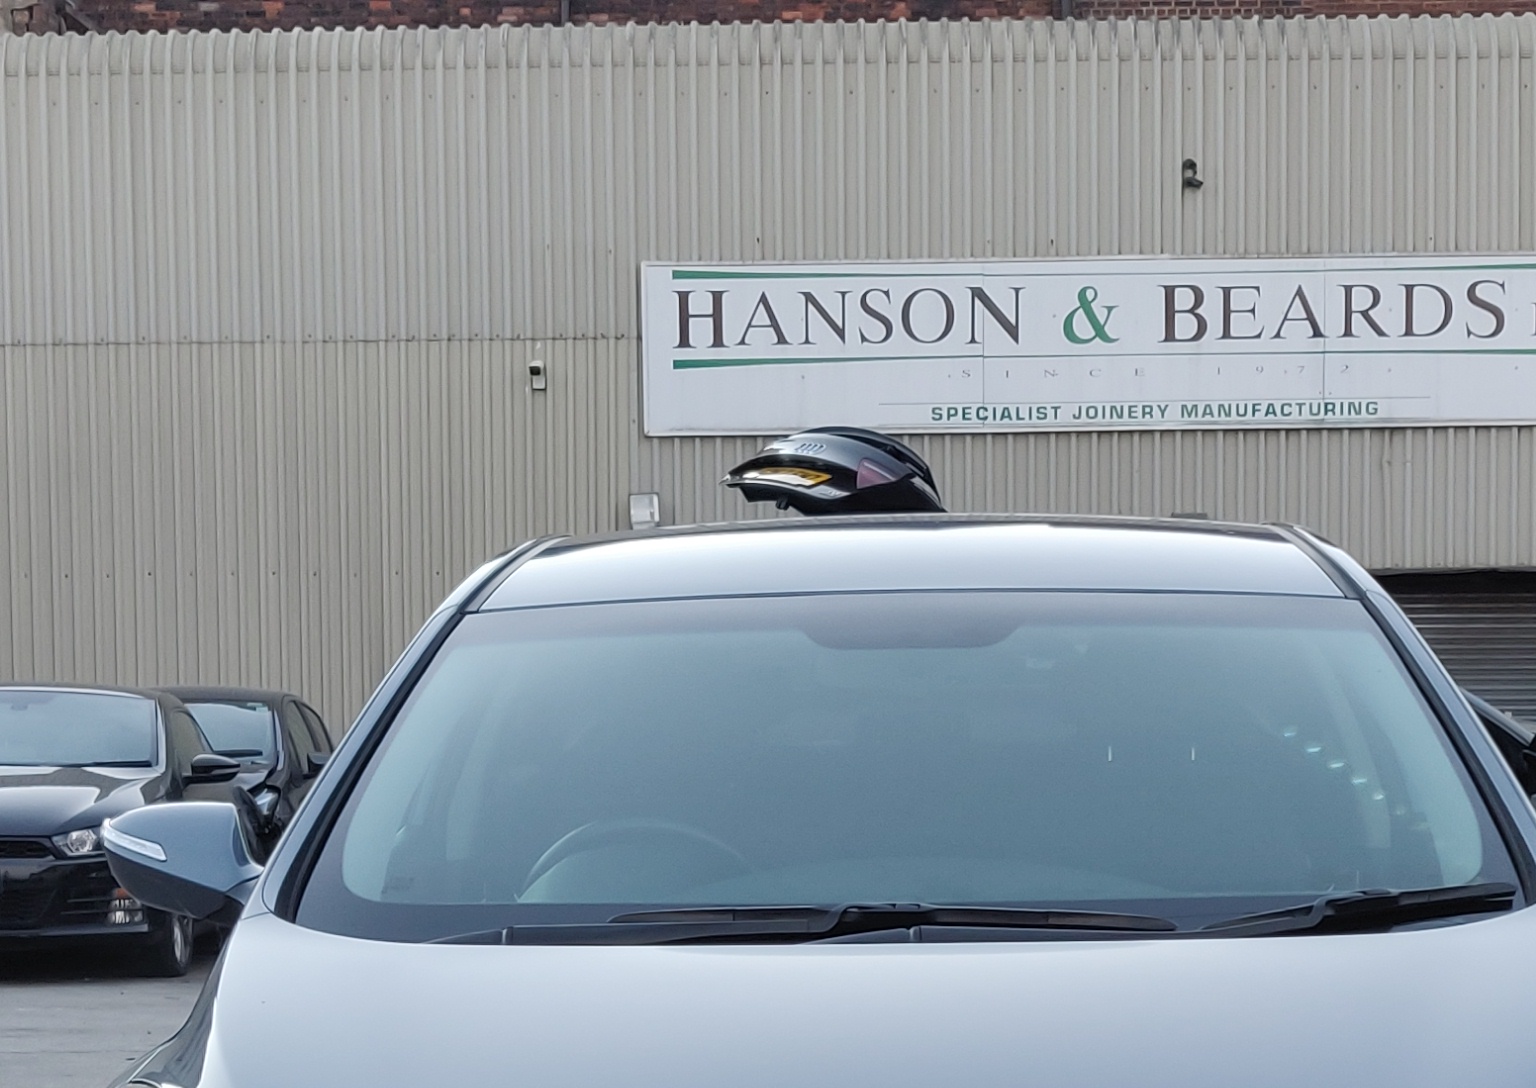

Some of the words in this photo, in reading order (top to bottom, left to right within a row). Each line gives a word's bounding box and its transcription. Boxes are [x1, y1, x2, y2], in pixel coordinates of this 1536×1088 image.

[671, 286, 1027, 349] HANSON
[1062, 285, 1120, 344] &
[1156, 279, 1506, 344] BEARDS
[960, 367, 1146, 379] SINCE
[1216, 364, 1350, 376] 1972
[930, 404, 1063, 423] SPECIALIST
[1071, 403, 1170, 421] JOINERY
[1179, 400, 1380, 420] MANUFACTURING
